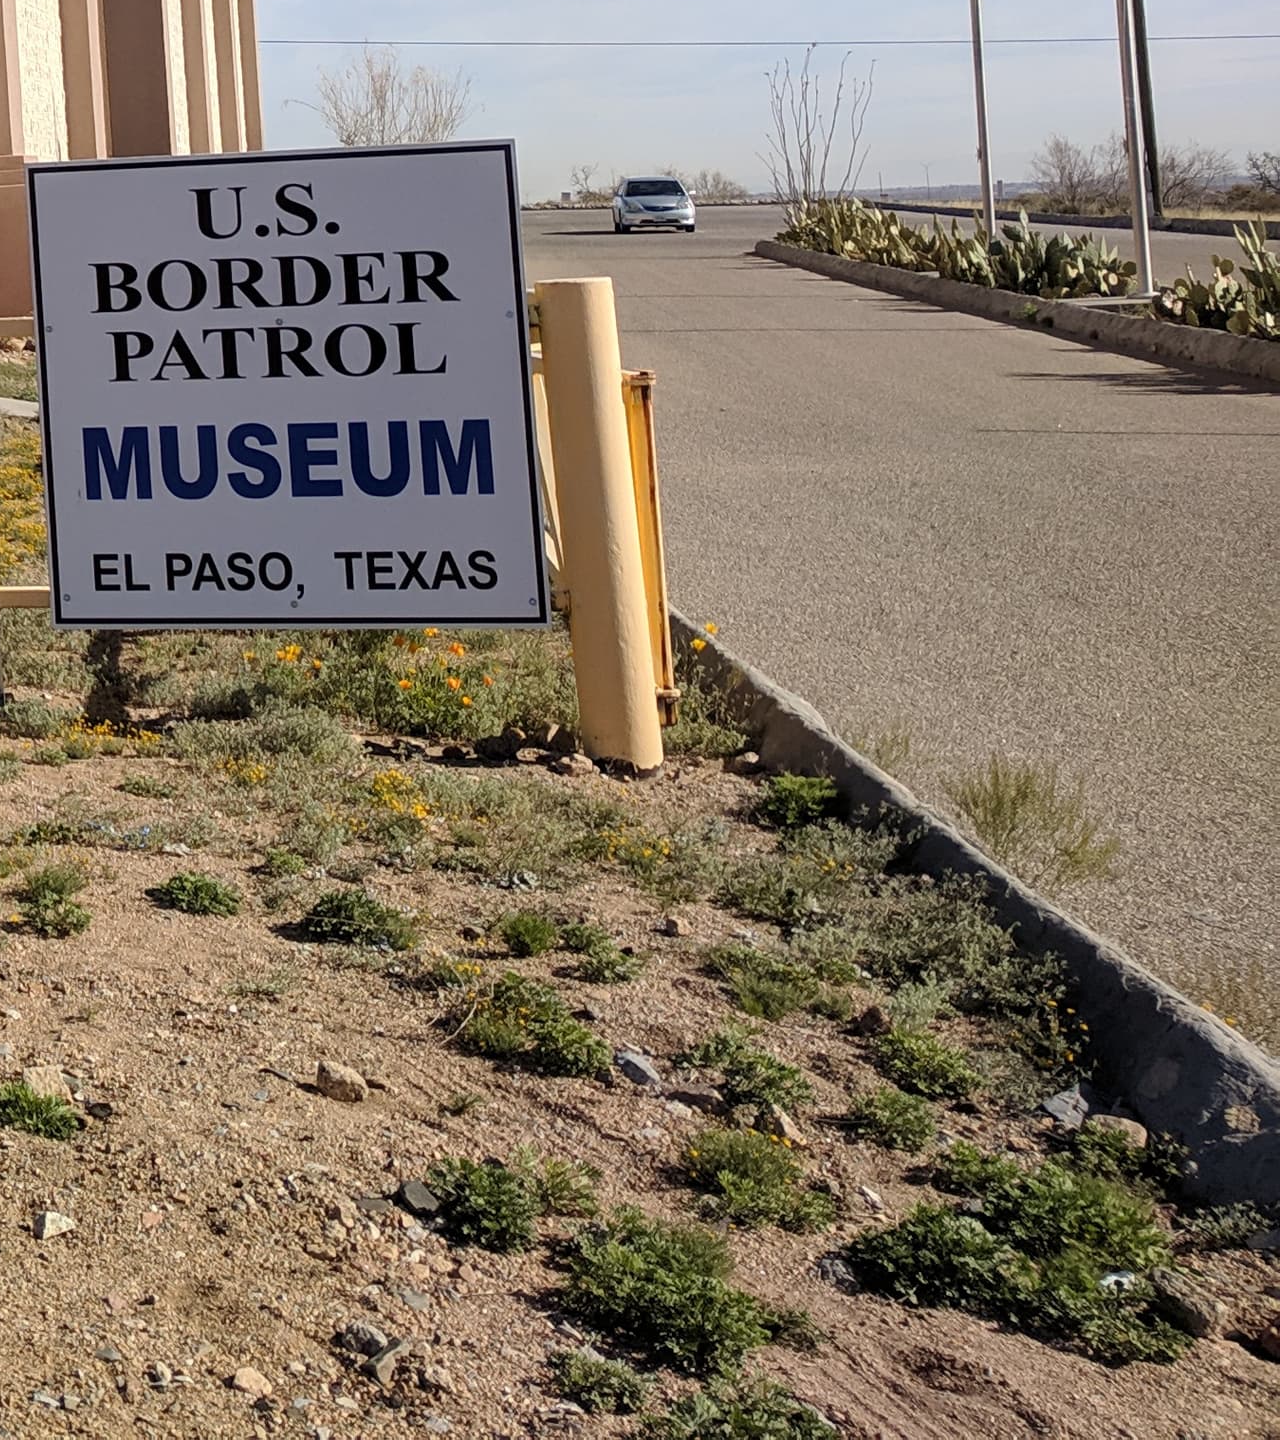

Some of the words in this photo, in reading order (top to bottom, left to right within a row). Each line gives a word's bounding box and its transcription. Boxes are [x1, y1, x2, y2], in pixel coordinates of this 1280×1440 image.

[188, 183, 340, 240] U.S.
[88, 250, 461, 313] BORDER
[106, 322, 448, 382] PATROL
[82, 418, 496, 501] MUSEUM
[93, 553, 151, 592] EL
[166, 552, 306, 600] PASO,
[334, 550, 499, 591] TEXAS
